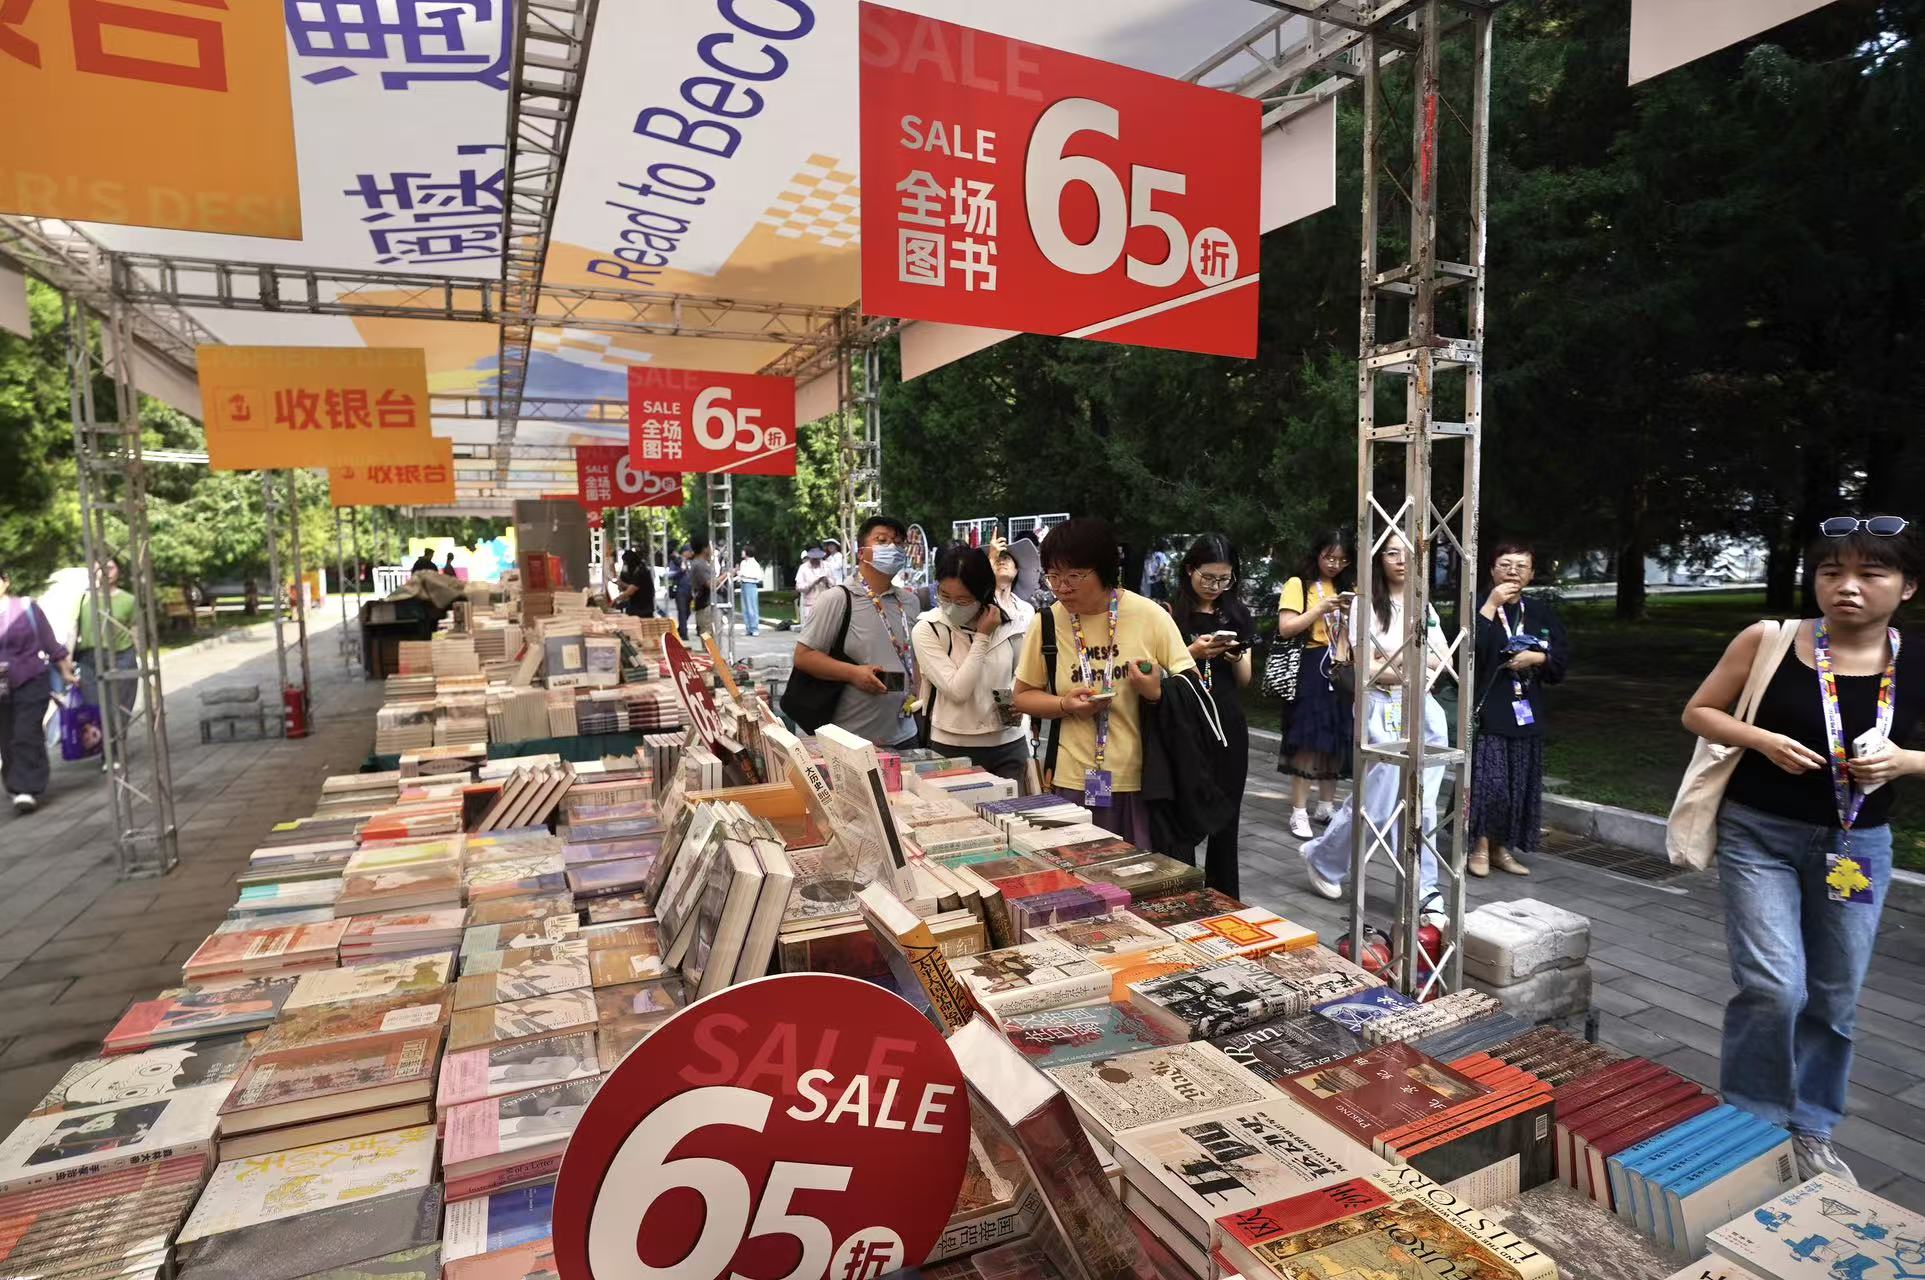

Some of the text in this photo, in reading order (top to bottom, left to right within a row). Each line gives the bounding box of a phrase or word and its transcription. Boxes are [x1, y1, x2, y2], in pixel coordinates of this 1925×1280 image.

[900, 114, 997, 165] SALE
[617, 163, 717, 206] to
[896, 169, 997, 238] 全场
[586, 200, 690, 287] Read
[899, 228, 997, 292] 图书
[275, 387, 417, 430] 收银台
[642, 400, 682, 415] SALE
[641, 419, 683, 440] 全场
[641, 440, 683, 460] 图书
[367, 464, 446, 485] 收银台
[584, 464, 610, 475] SALE
[585, 476, 611, 489] 全场
[803, 765, 825, 792] 大历史
[786, 1068, 957, 1135] SALE
[1335, 1103, 1371, 1130] PEKING
[1236, 1115, 1337, 1179] 运动史
[1237, 1182, 1374, 1239] 欧洲
[1386, 1166, 1541, 1263] HISTORY
[1413, 1192, 1521, 1266] AND THE PEOPLE WITHOUT
